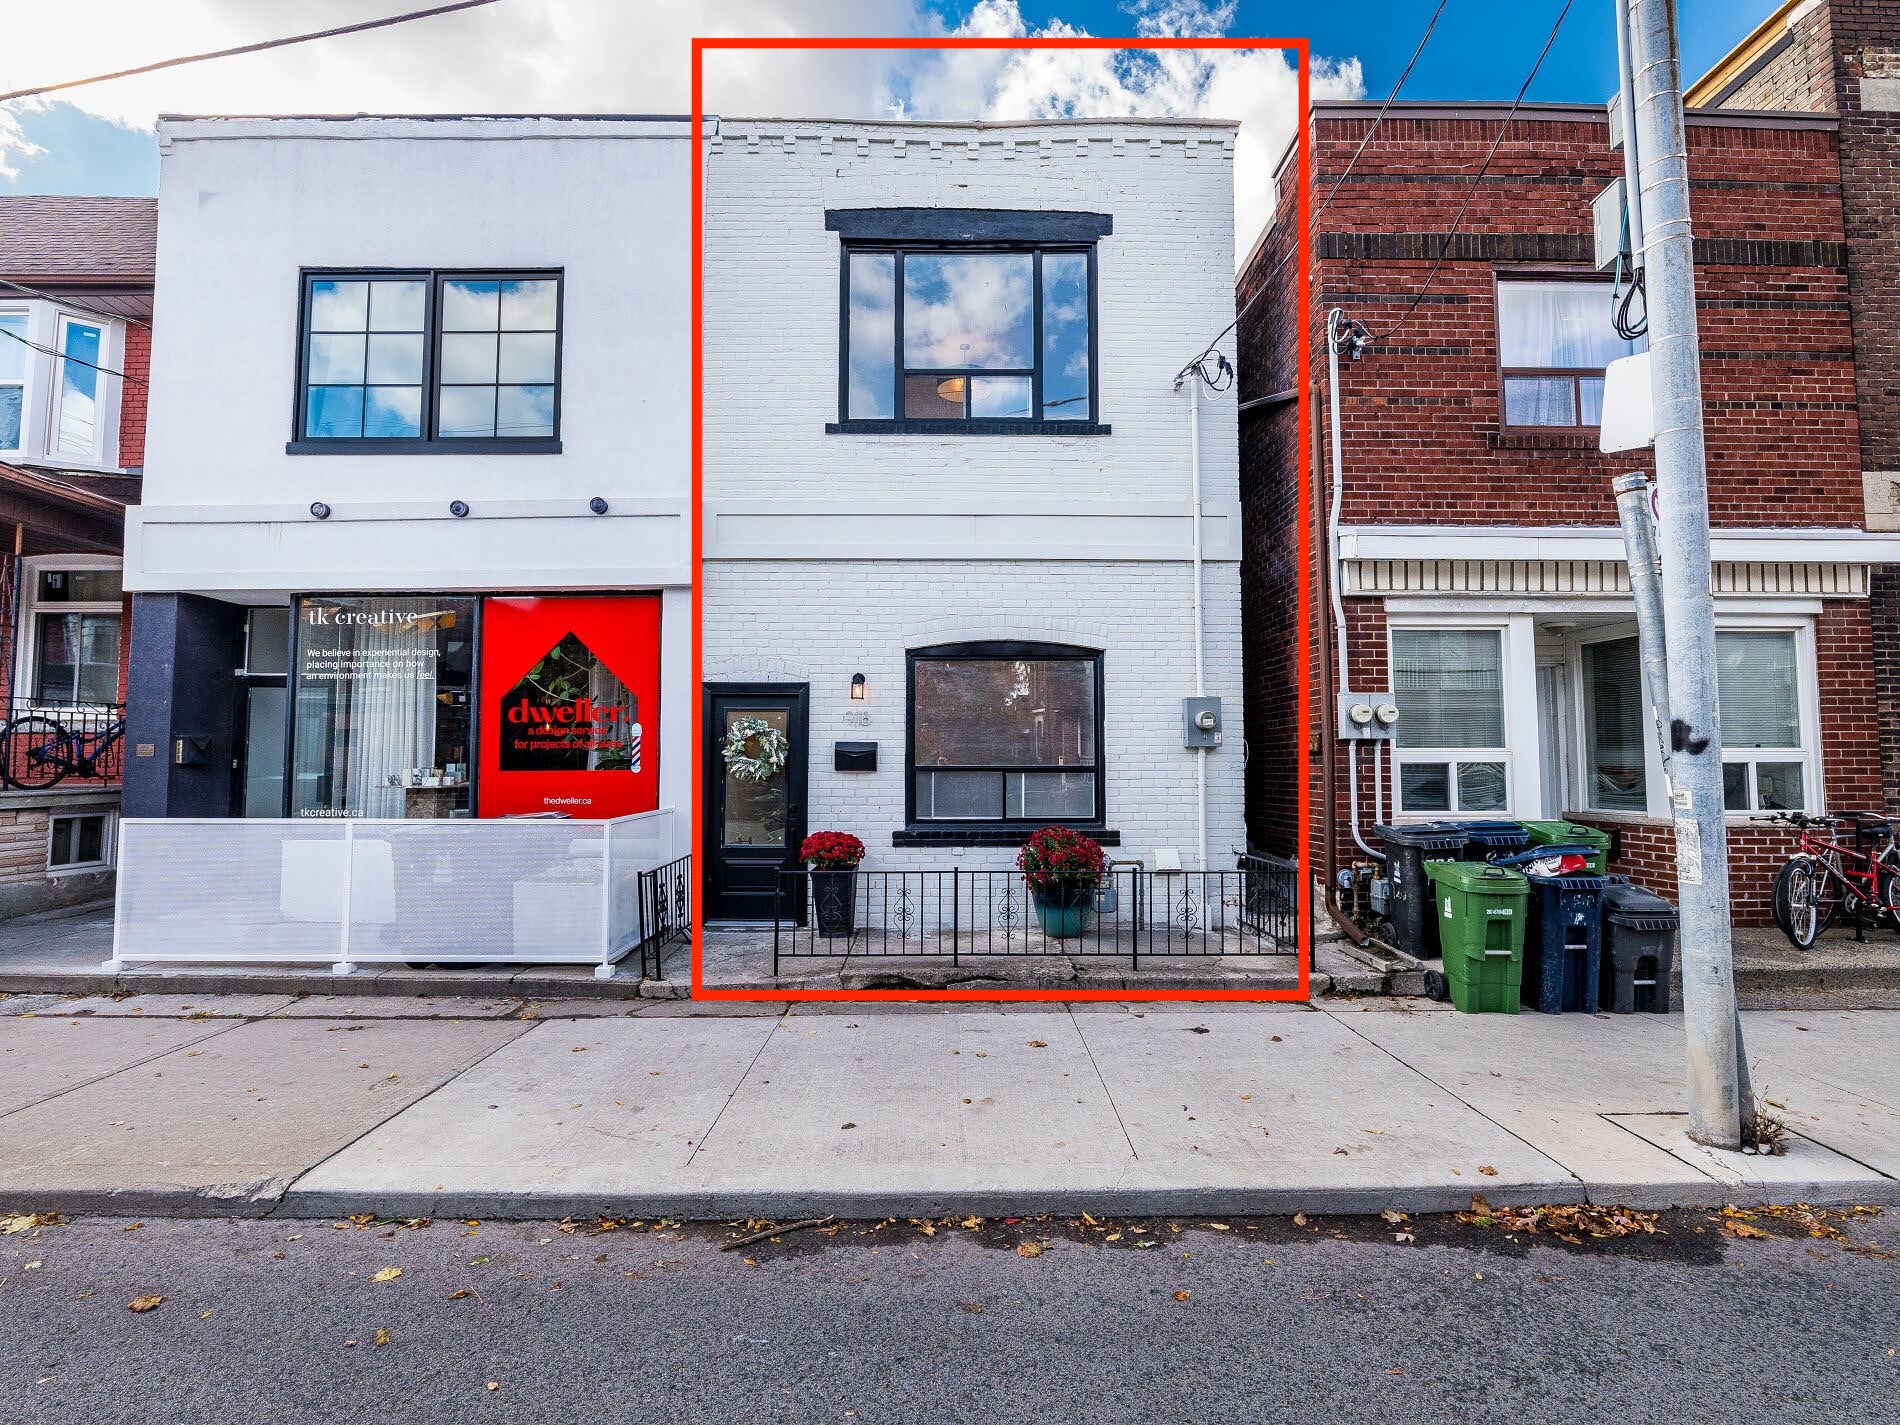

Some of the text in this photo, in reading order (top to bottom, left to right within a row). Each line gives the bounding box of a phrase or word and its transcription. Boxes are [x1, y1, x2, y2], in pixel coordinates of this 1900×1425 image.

[308, 607, 418, 625] tk creative
[307, 648, 441, 659] We believe in experiential design,
[306, 659, 425, 670] placing importance on how
[306, 672, 318, 680] an
[318, 671, 372, 680] environment
[373, 670, 402, 679] makes
[416, 670, 435, 680] feel.
[507, 698, 631, 723] dweller.
[527, 726, 609, 737] a design service
[514, 739, 529, 749] for
[530, 739, 571, 751] projects
[572, 739, 583, 749] of
[543, 796, 592, 805] thedweller.ca
[299, 807, 364, 817] tkcreative.ca
